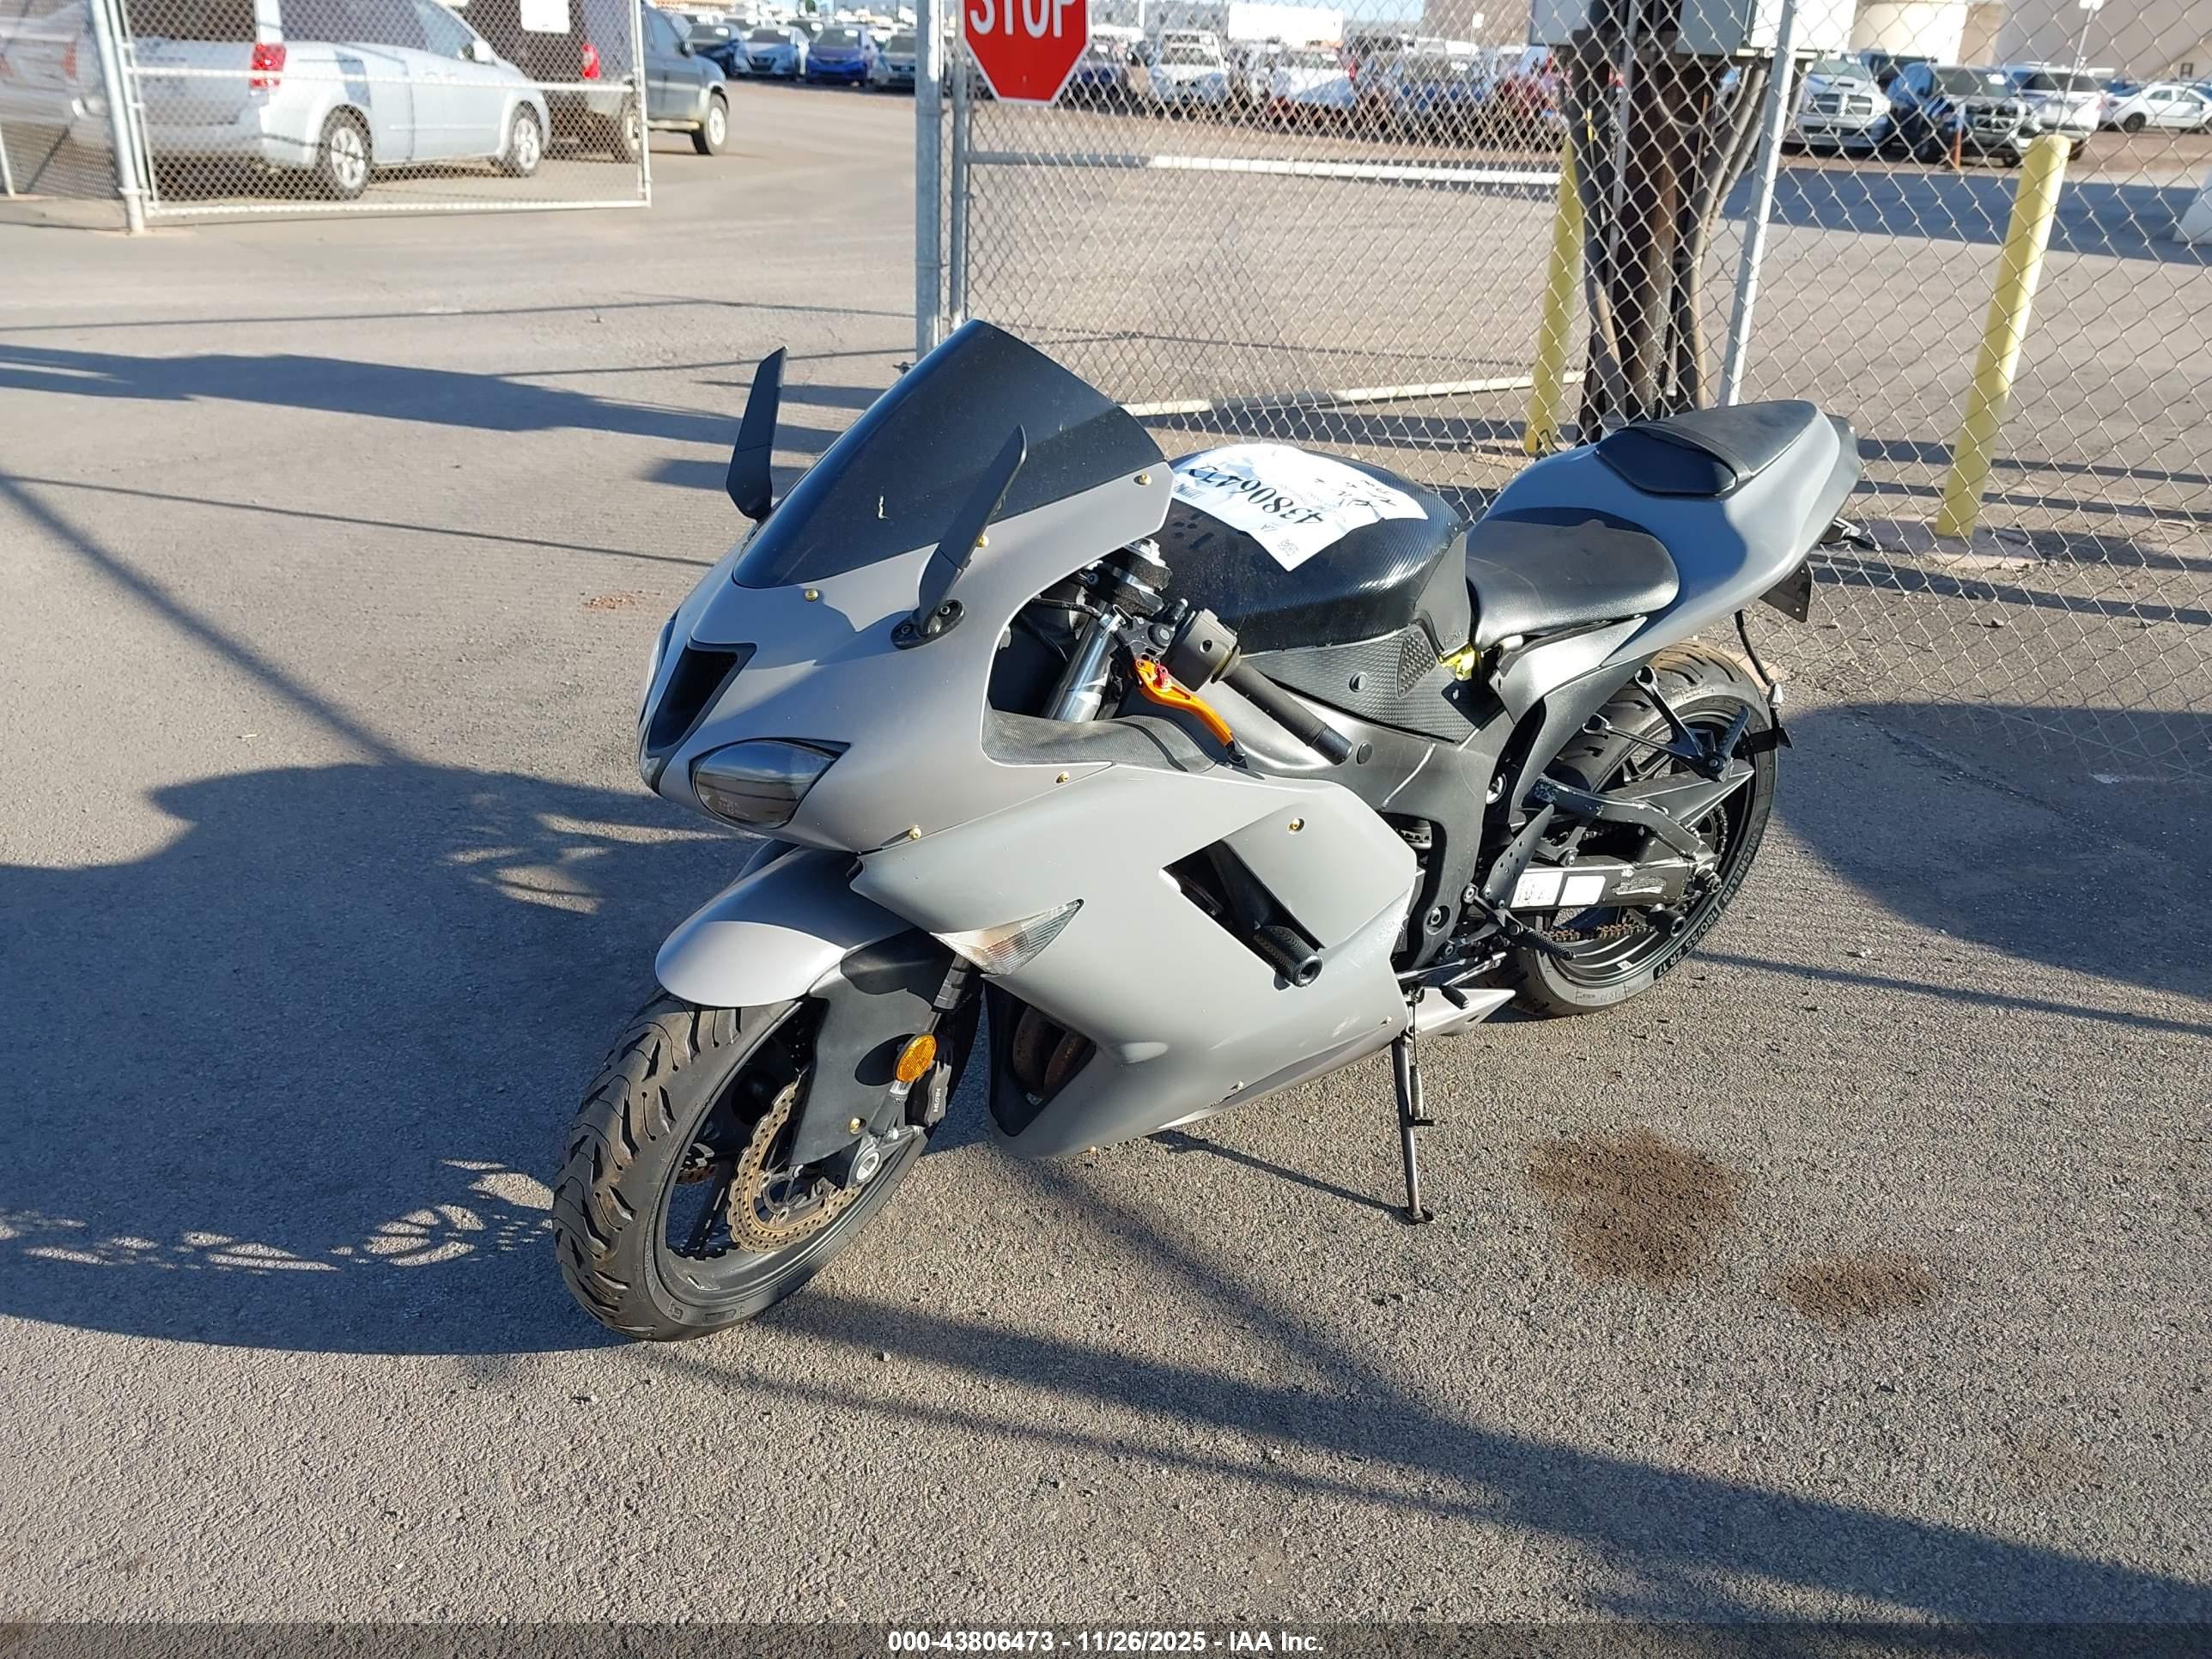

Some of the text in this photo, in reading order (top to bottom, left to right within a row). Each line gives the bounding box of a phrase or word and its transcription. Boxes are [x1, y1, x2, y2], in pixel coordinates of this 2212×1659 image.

[1722, 833, 1759, 903] MICHELIN
[1657, 910, 1718, 977] 180/55 ZR 17
